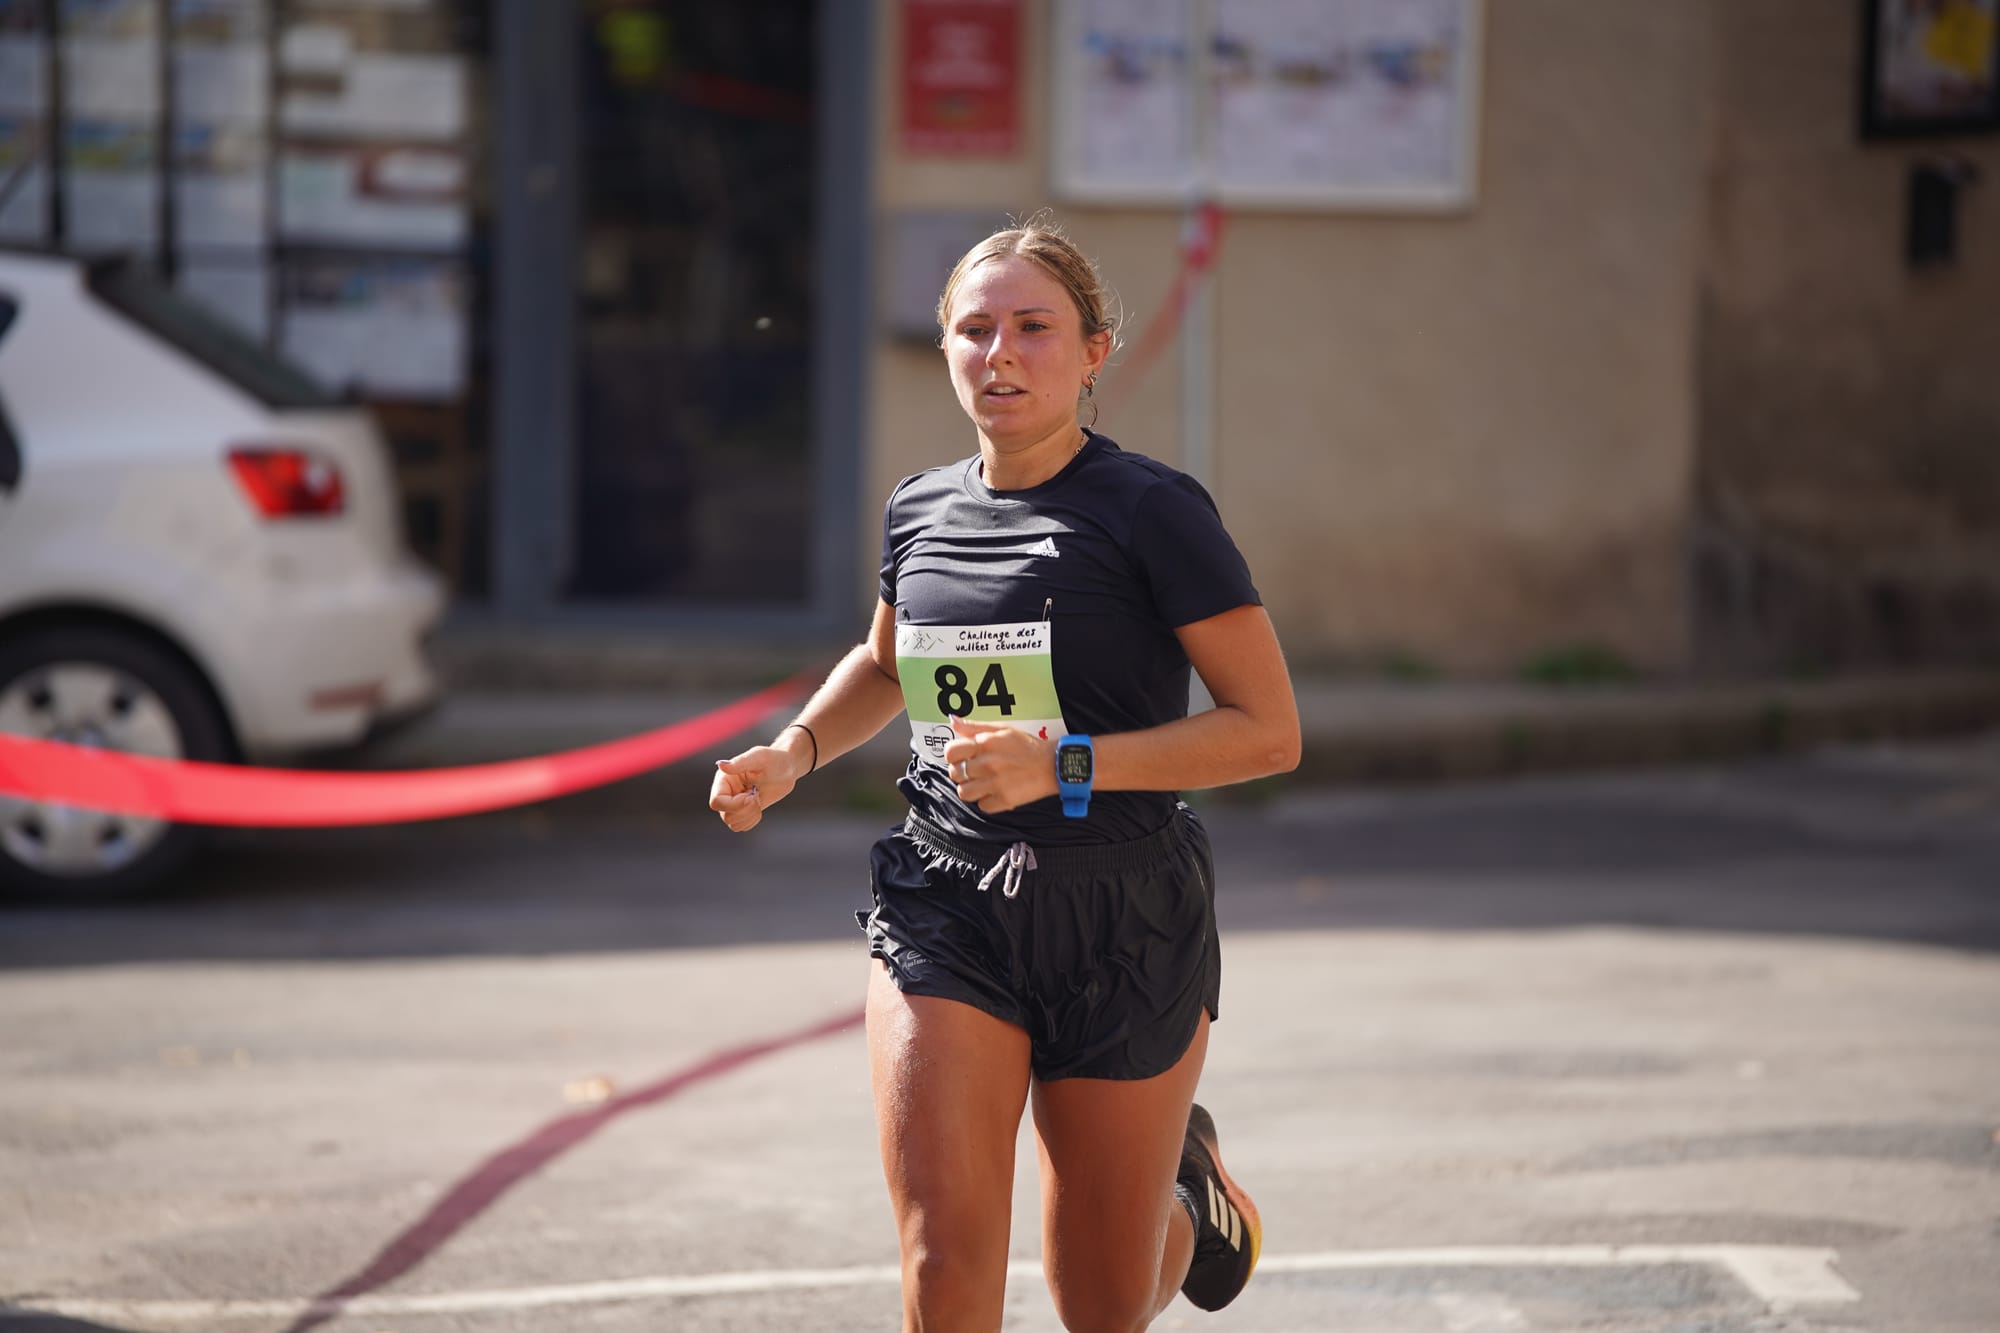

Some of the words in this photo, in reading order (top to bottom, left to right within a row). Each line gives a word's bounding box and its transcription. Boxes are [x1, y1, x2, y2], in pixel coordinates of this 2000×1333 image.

[959, 630, 1010, 642] Challenge
[1017, 628, 1036, 638] des
[956, 641, 989, 652] vallées
[995, 639, 1042, 651] cévenoles
[934, 663, 1016, 718] 84
